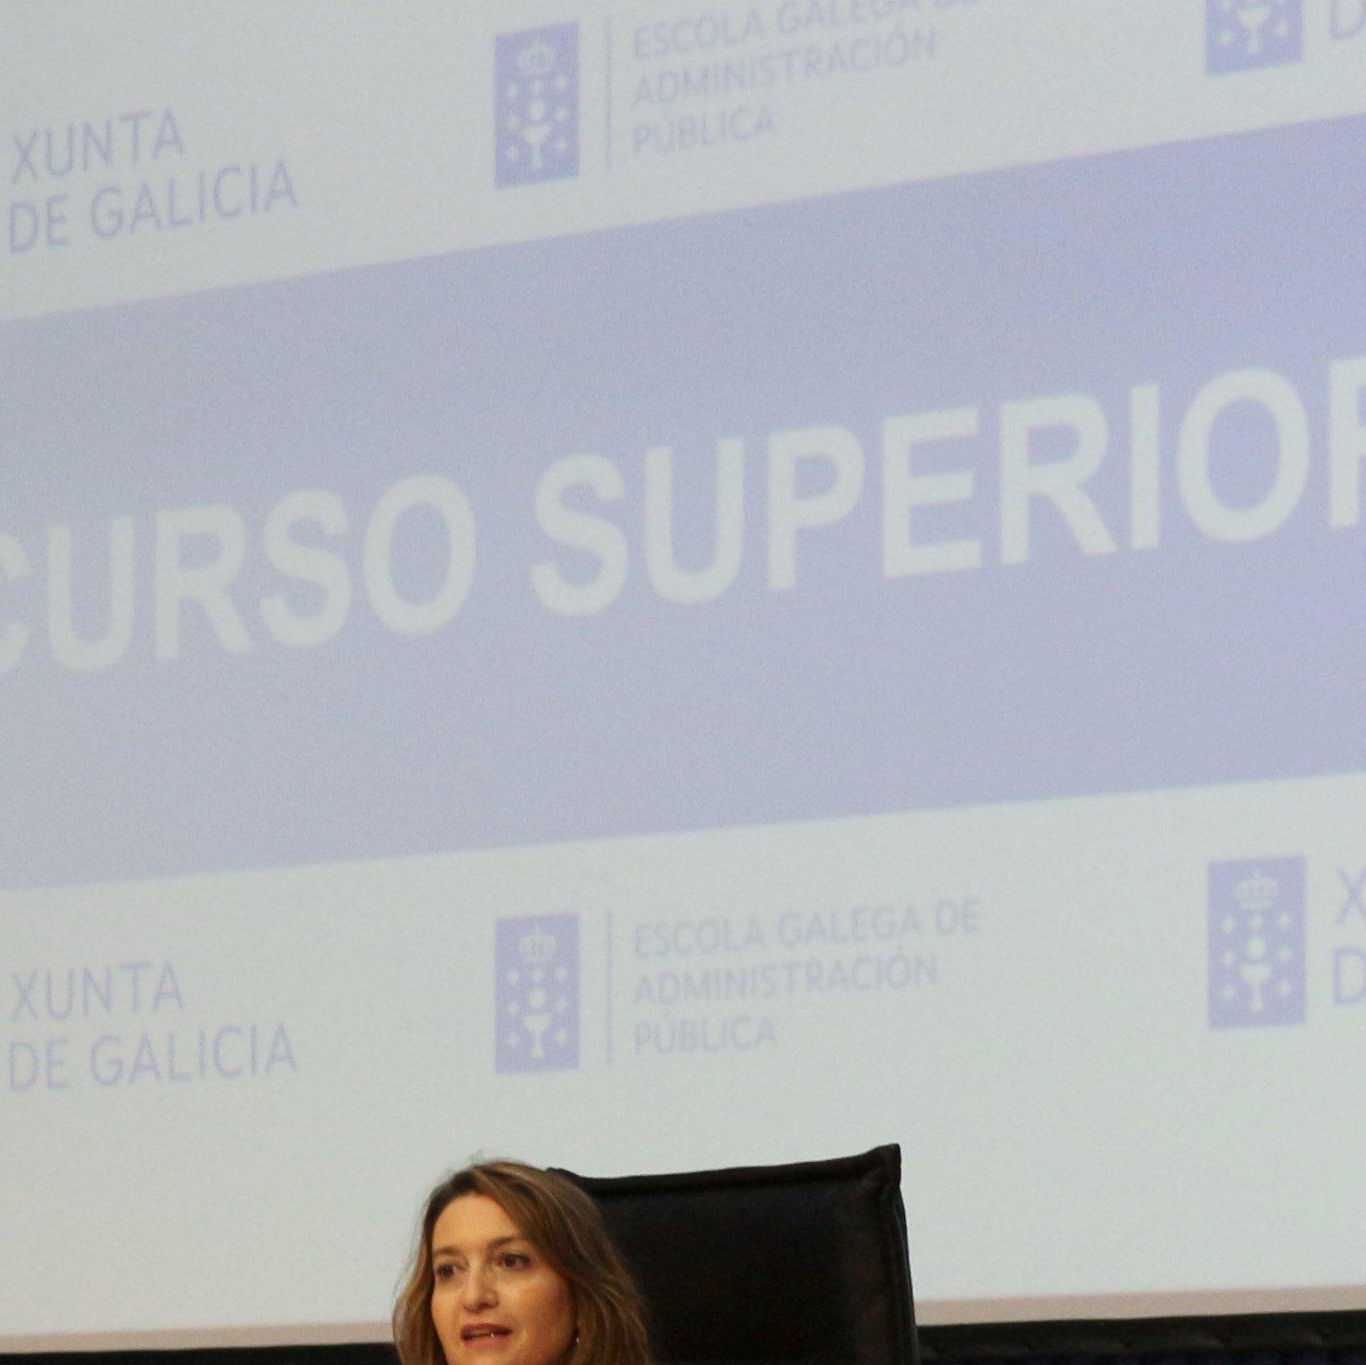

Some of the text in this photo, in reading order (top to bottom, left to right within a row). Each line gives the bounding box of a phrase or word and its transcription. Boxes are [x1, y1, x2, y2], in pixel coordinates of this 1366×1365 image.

[634, 10, 764, 59] ESCOLA
[634, 22, 935, 104] ADMINISTRACIÓN
[11, 106, 187, 184] XUNTA
[9, 157, 298, 254] DE GALICIA
[634, 898, 981, 959] ESCOLA GALEGA DE
[11, 960, 185, 1023] XUNTA
[635, 947, 939, 1007] ADMINISTRACIÓN
[9, 1023, 298, 1092] DE GALICIA
